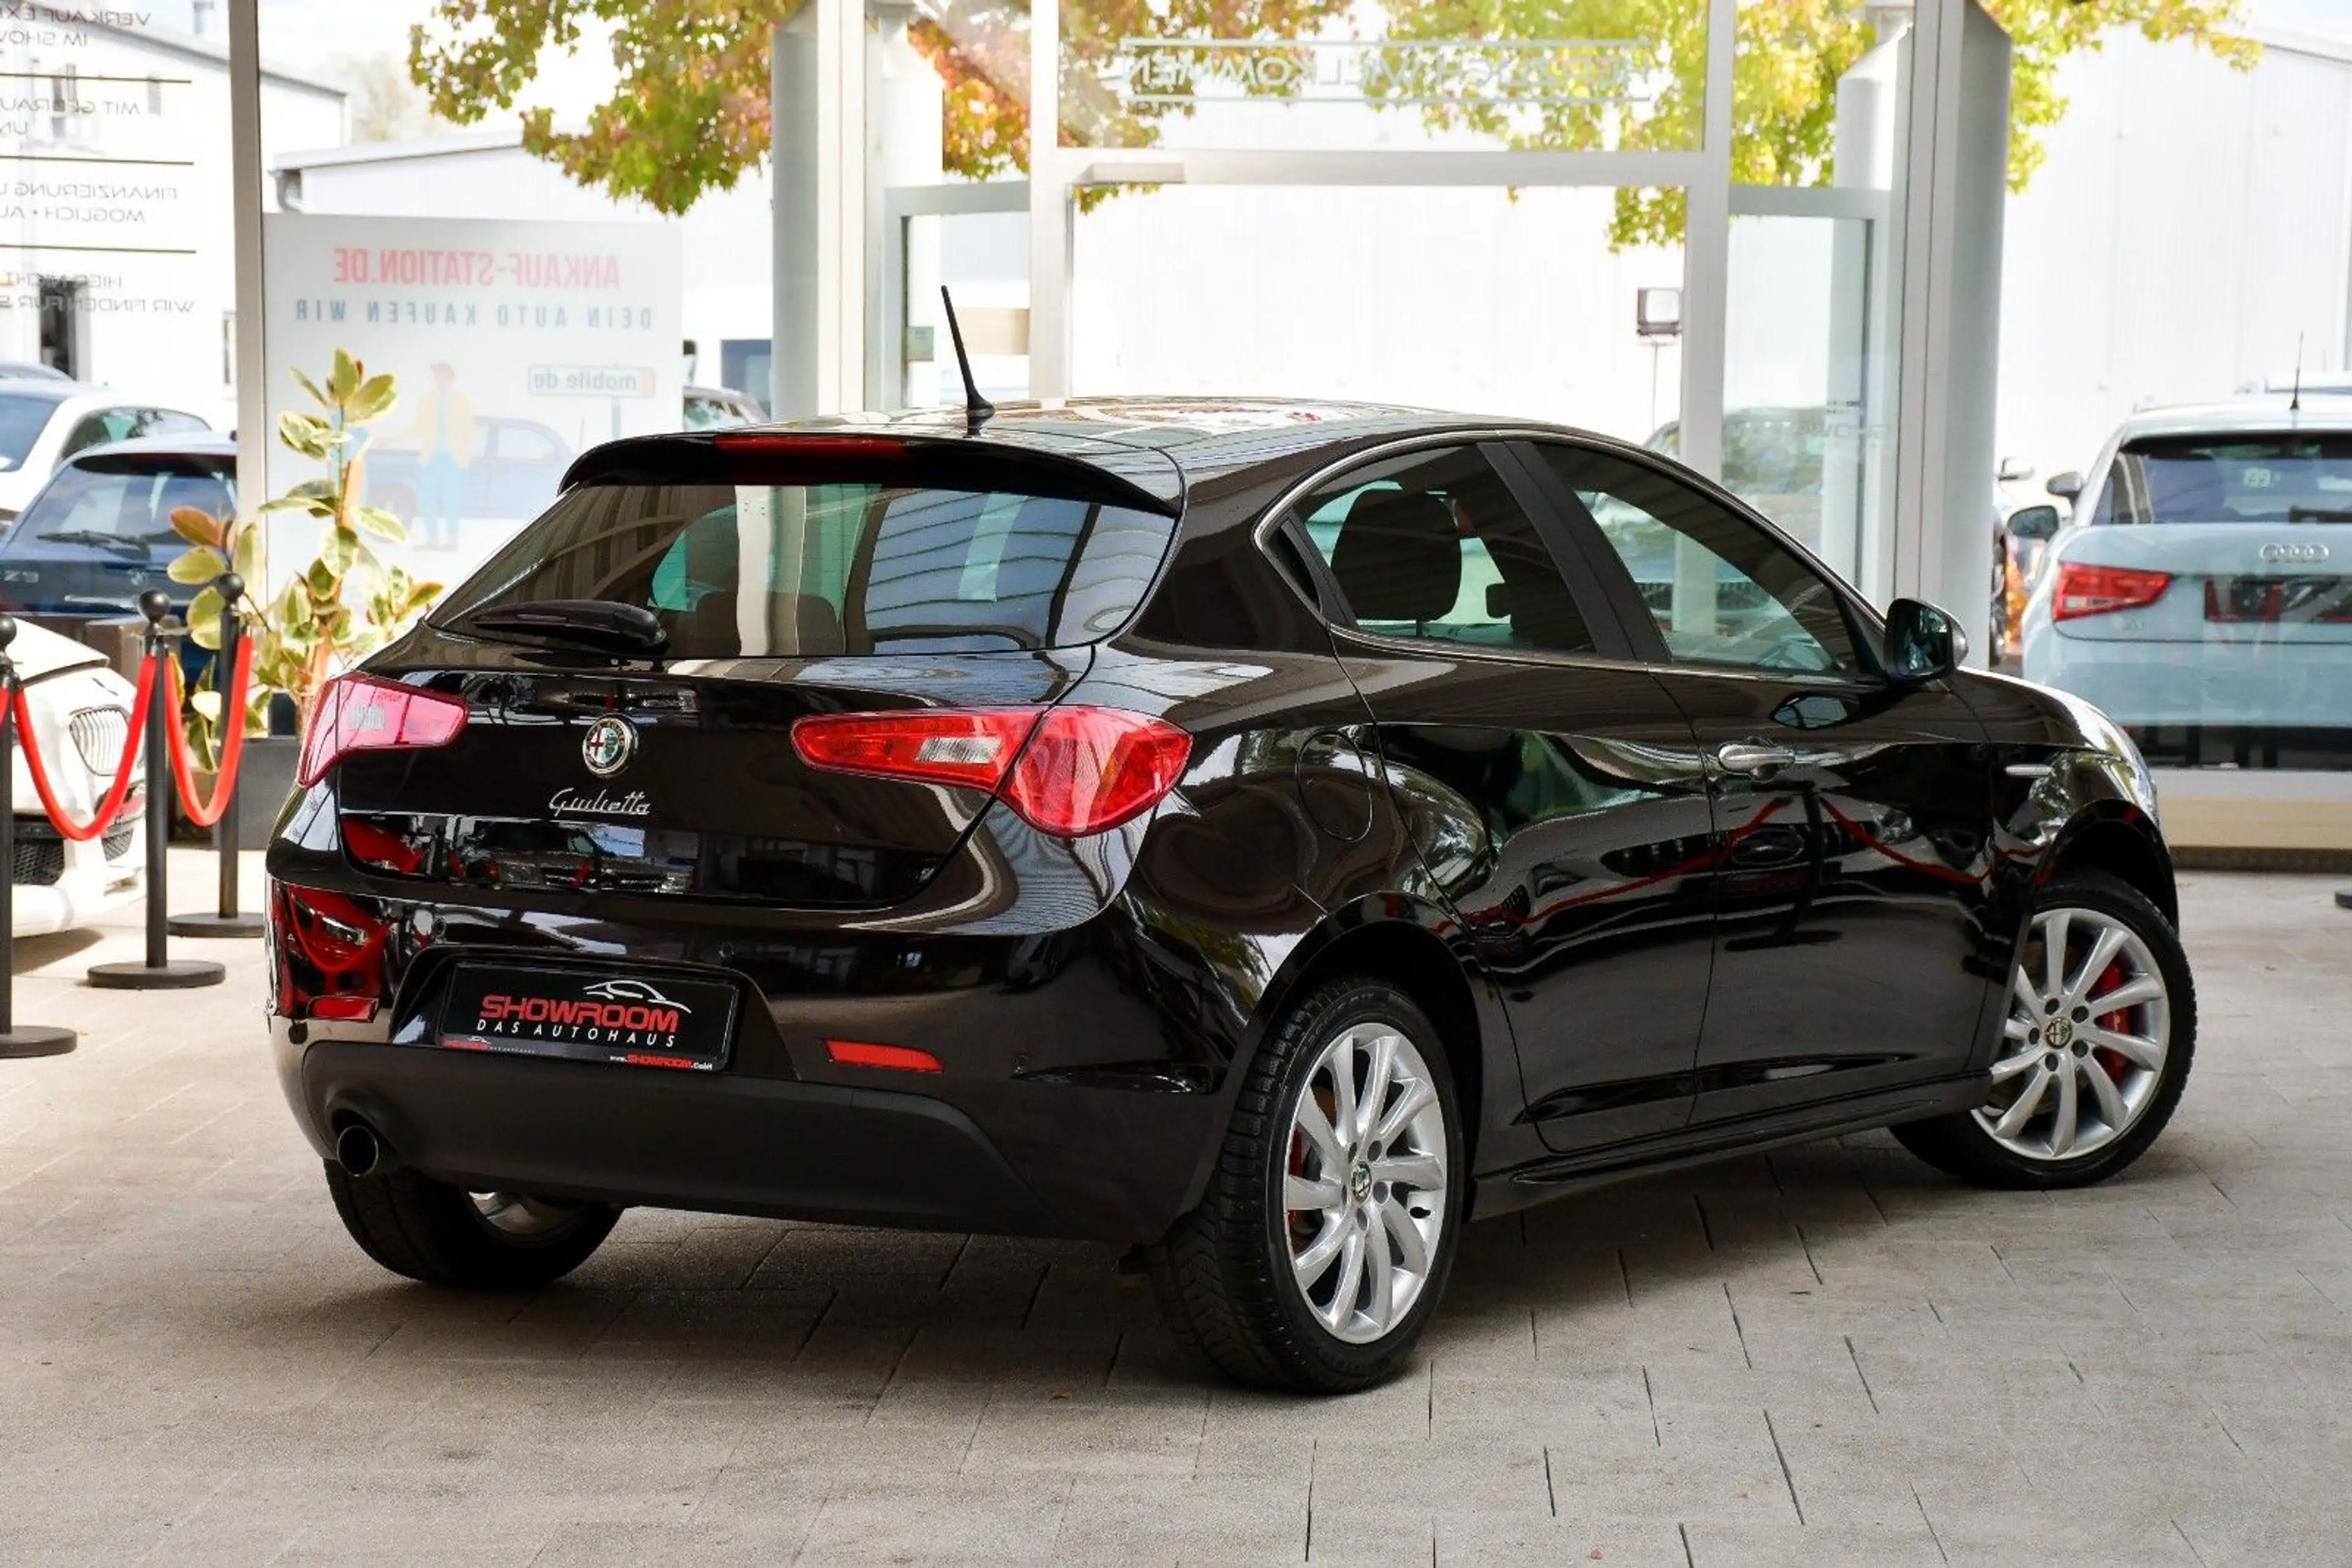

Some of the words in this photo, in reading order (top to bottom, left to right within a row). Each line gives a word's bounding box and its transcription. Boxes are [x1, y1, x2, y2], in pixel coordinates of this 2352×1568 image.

[548, 787, 651, 817] Giulietta
[480, 994, 679, 1033] SHOWROOM
[477, 1019, 521, 1035] DAS
[533, 1024, 675, 1048] AUTOHAUS
